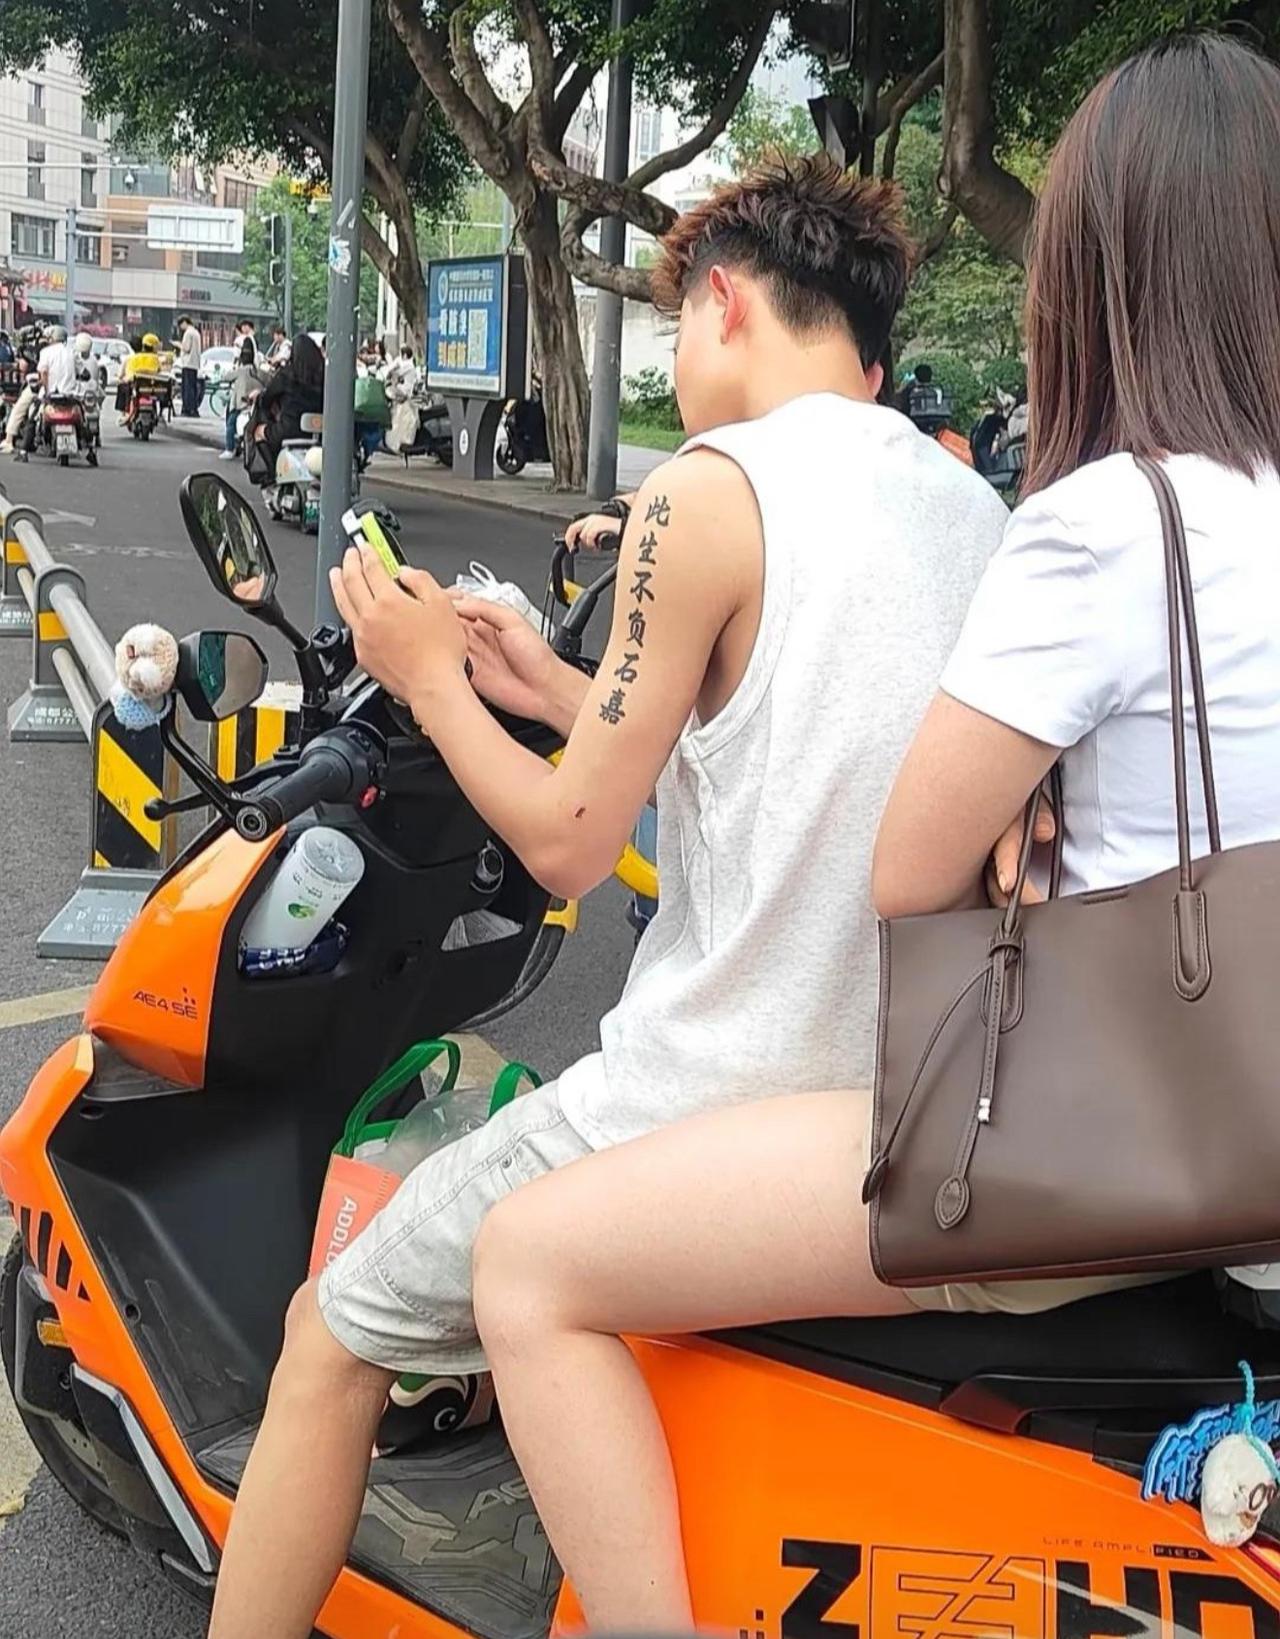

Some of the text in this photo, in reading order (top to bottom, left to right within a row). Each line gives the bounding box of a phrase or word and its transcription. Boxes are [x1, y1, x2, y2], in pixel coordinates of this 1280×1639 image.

[598, 494, 671, 725] 此生不负石嘉
